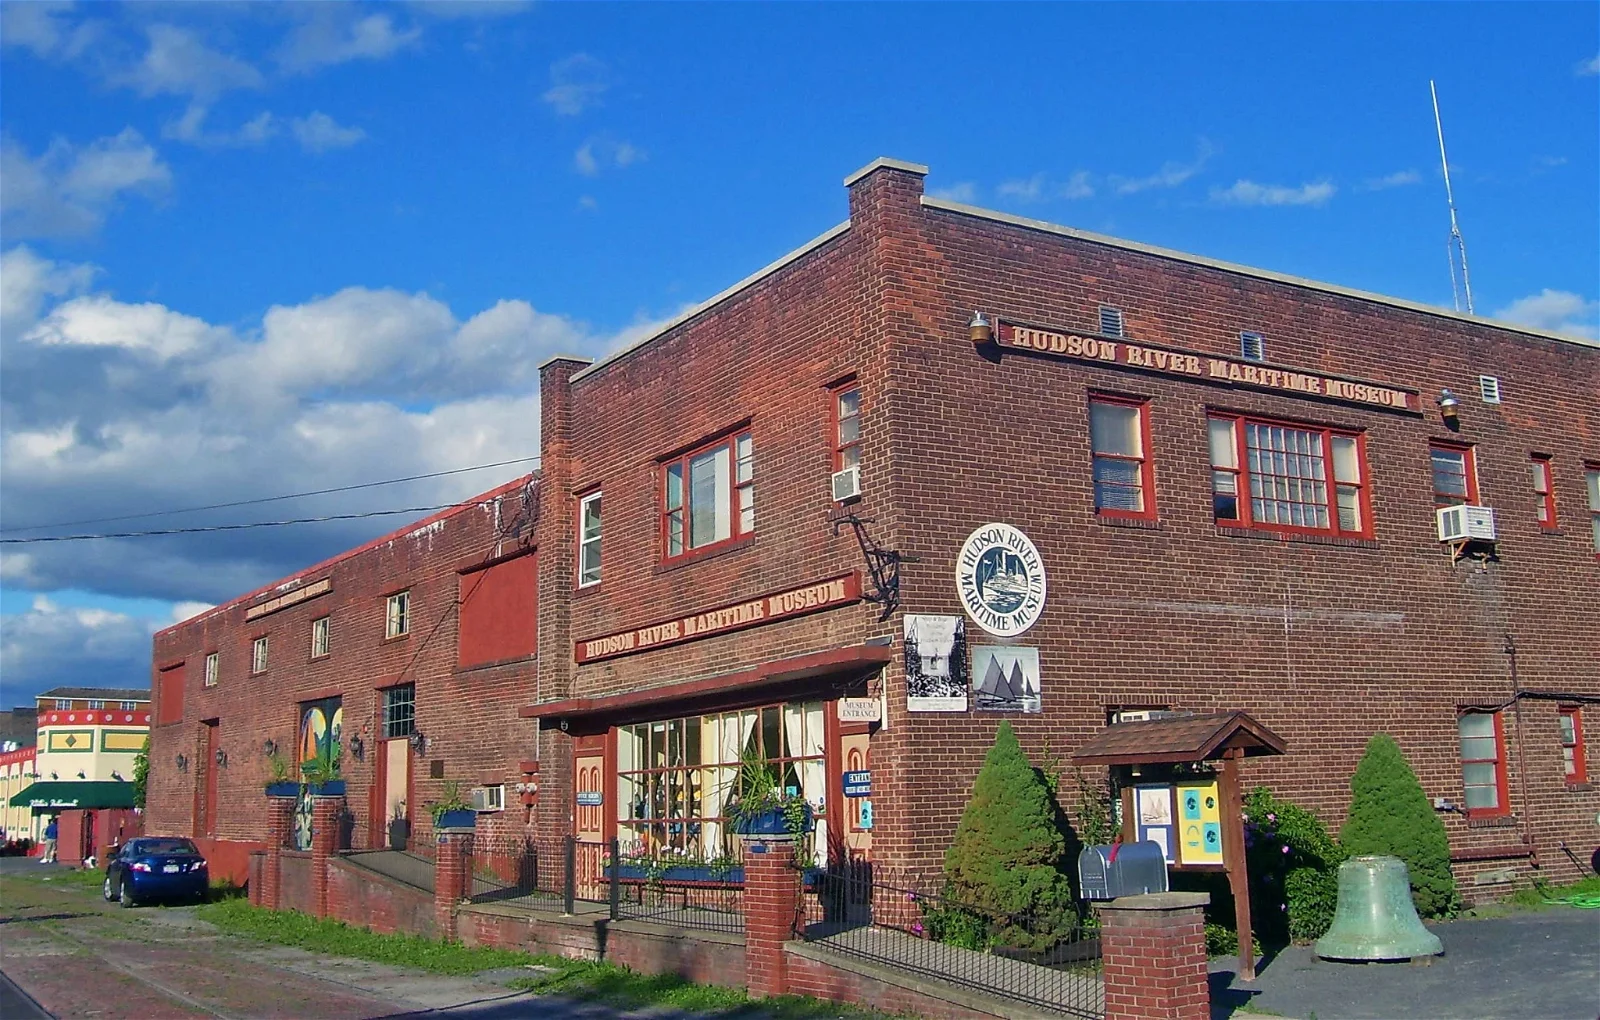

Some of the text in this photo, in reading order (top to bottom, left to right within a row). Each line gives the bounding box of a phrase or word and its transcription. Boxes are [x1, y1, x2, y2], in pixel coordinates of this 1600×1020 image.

[1012, 326, 1408, 409] HUDSON RIVER MARITIME MUSEUM
[963, 528, 1039, 571] HUDSON RIVER
[585, 579, 846, 659] HUDSON RIVER MARITIME MUSEUM
[960, 571, 1042, 631] MARITIME MUSEUM
[842, 709, 876, 718] ENTRANCE
[846, 701, 874, 709] MUSEUM
